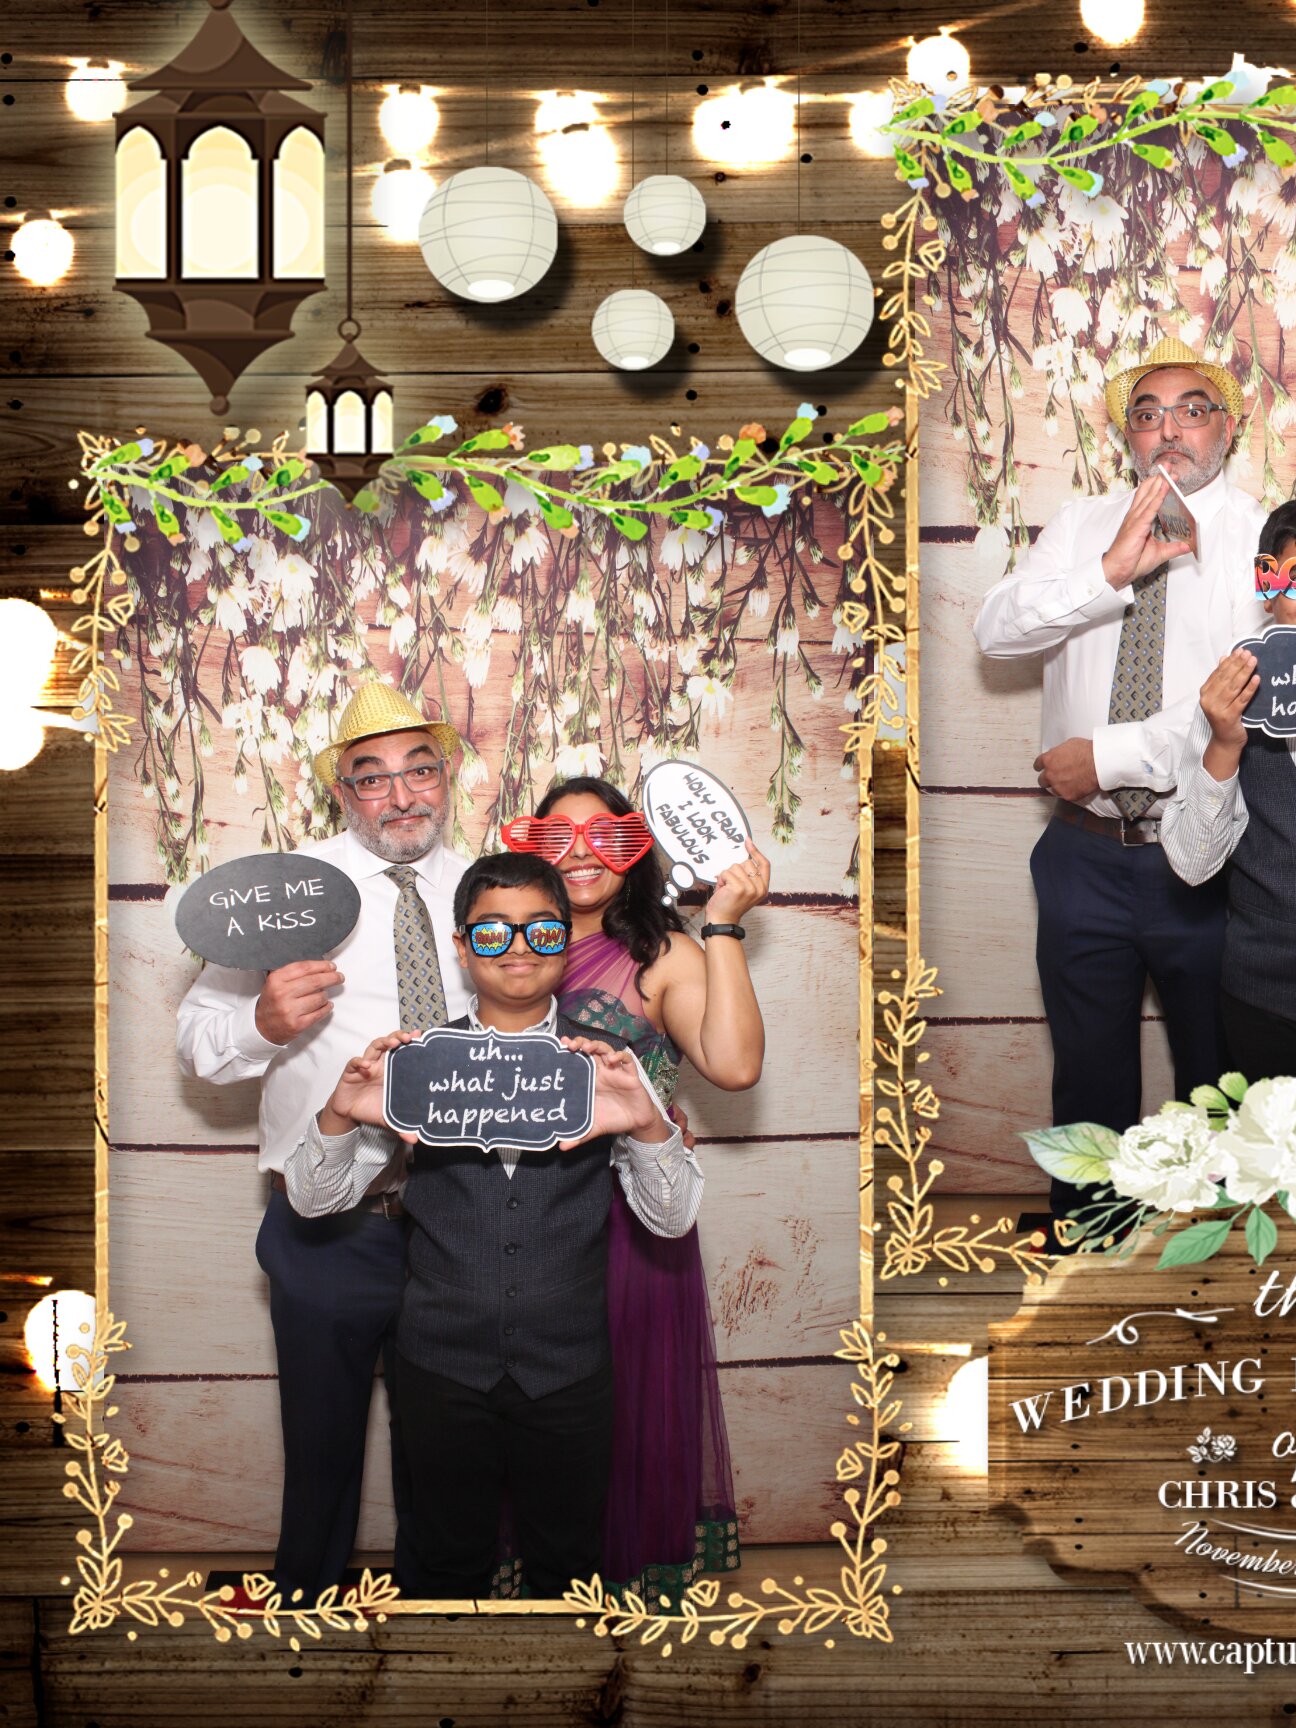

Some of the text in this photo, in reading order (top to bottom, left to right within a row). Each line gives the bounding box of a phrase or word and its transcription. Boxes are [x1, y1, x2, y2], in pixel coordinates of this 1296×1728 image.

[677, 800, 718, 845] I LOOK
[683, 772, 745, 850] HOLY CRAP,
[655, 803, 710, 864] FABULOUS
[285, 878, 325, 899] ME
[227, 916, 245, 937] A
[469, 1038, 524, 1062] uh...
[429, 1066, 566, 1101] what just
[427, 1097, 568, 1137] happened
